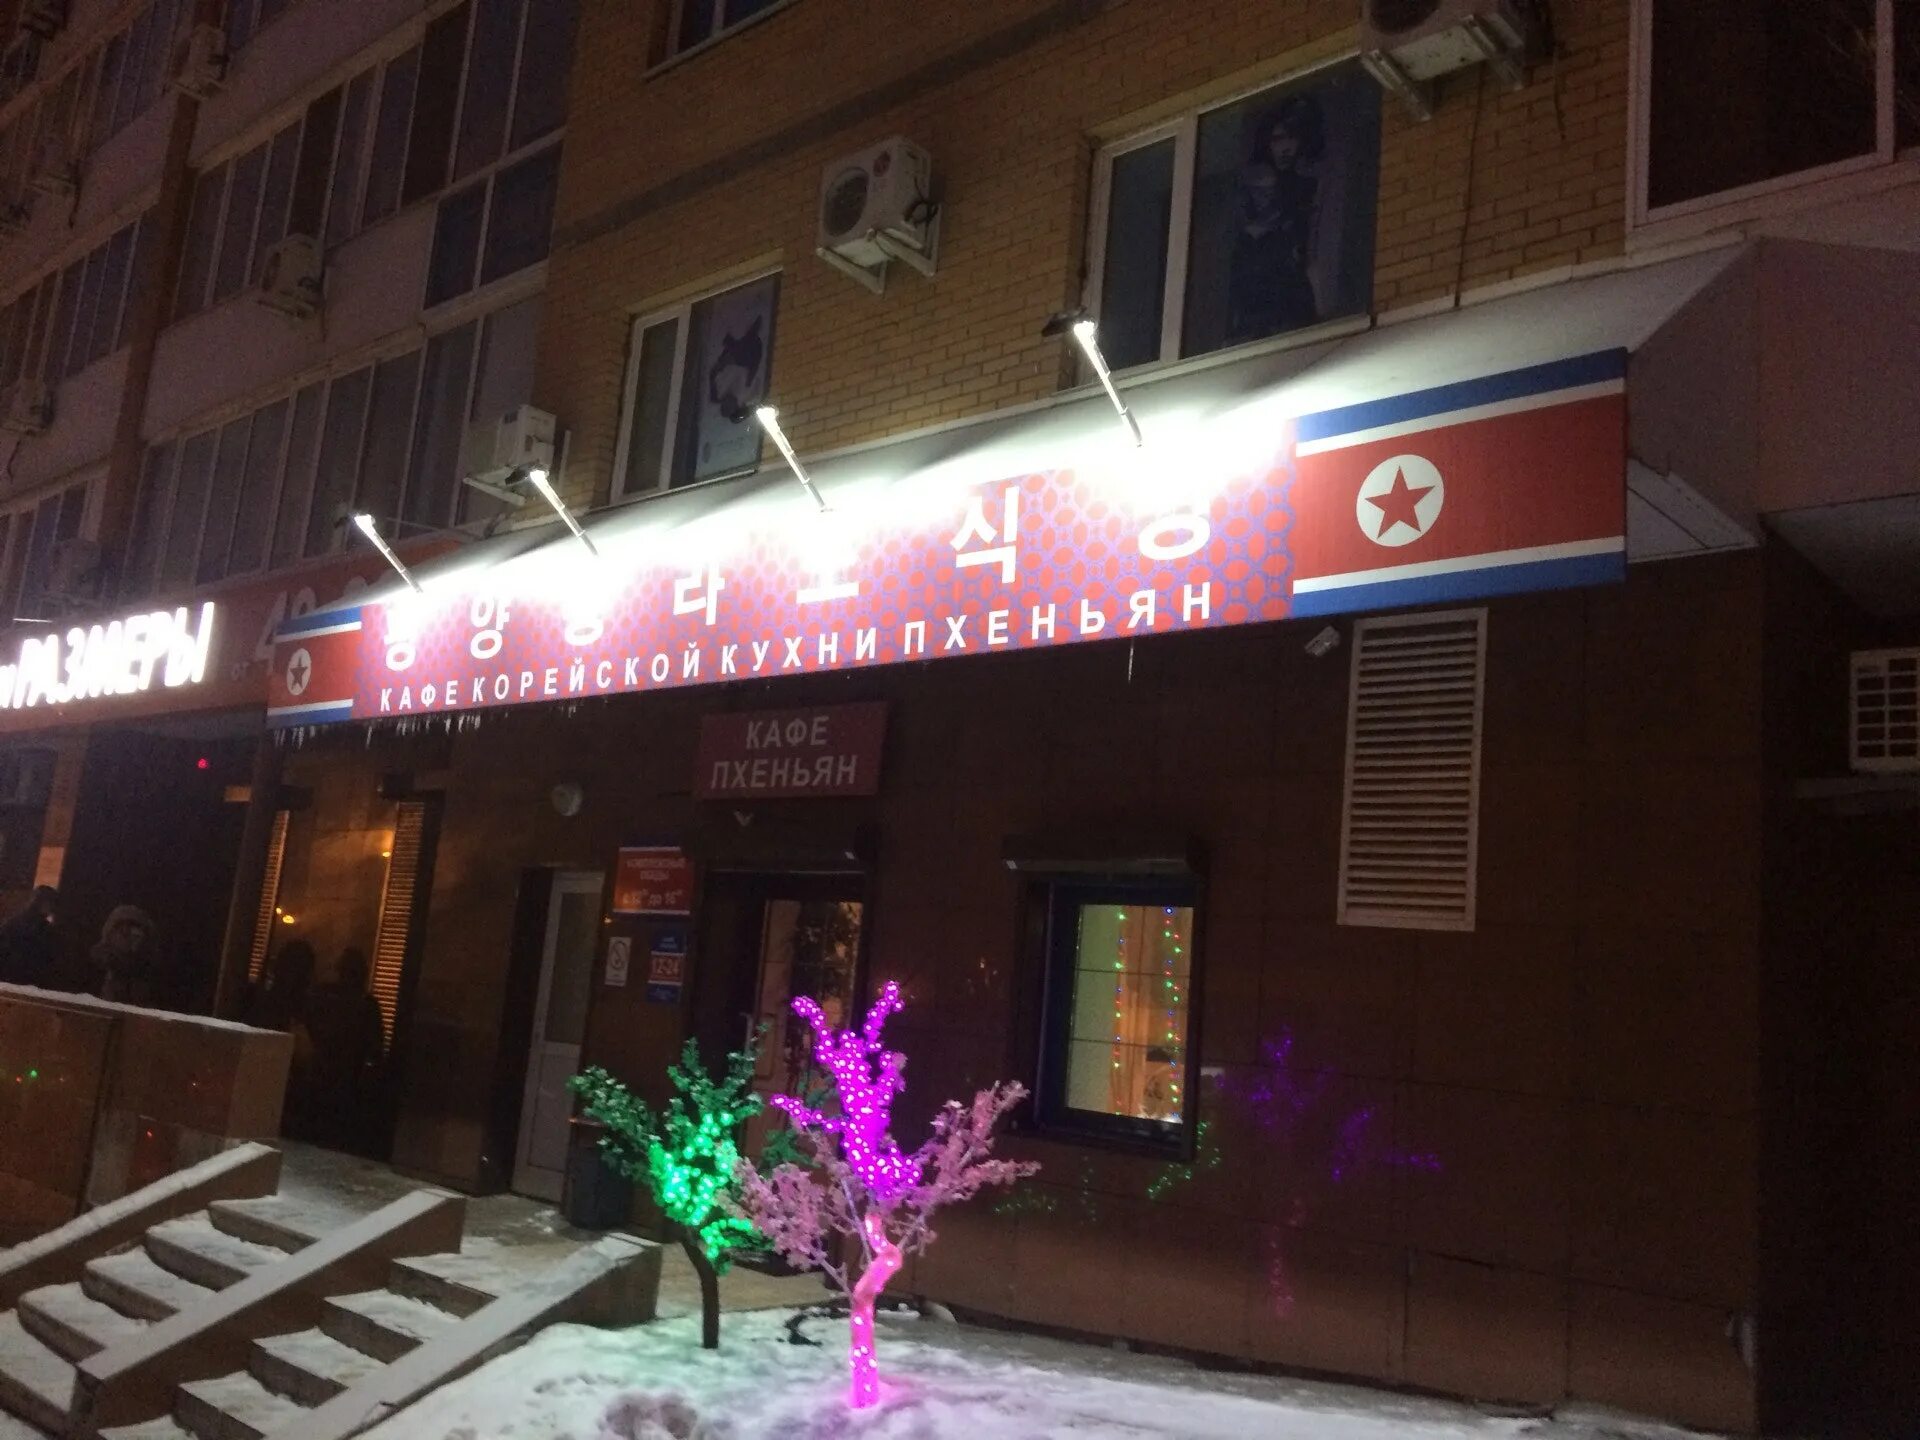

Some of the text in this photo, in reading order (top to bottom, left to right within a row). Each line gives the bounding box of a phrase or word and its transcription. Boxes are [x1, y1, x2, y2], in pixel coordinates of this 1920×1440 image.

[13, 602, 215, 709] РАЗМЕРЫ
[380, 581, 1212, 711] КАФЕ КОРЕЙСКОЙ КУХНИ ПХЕНЬЯН
[745, 715, 830, 750] КАФЕ
[710, 753, 858, 790] ПХЕНЬЯН
